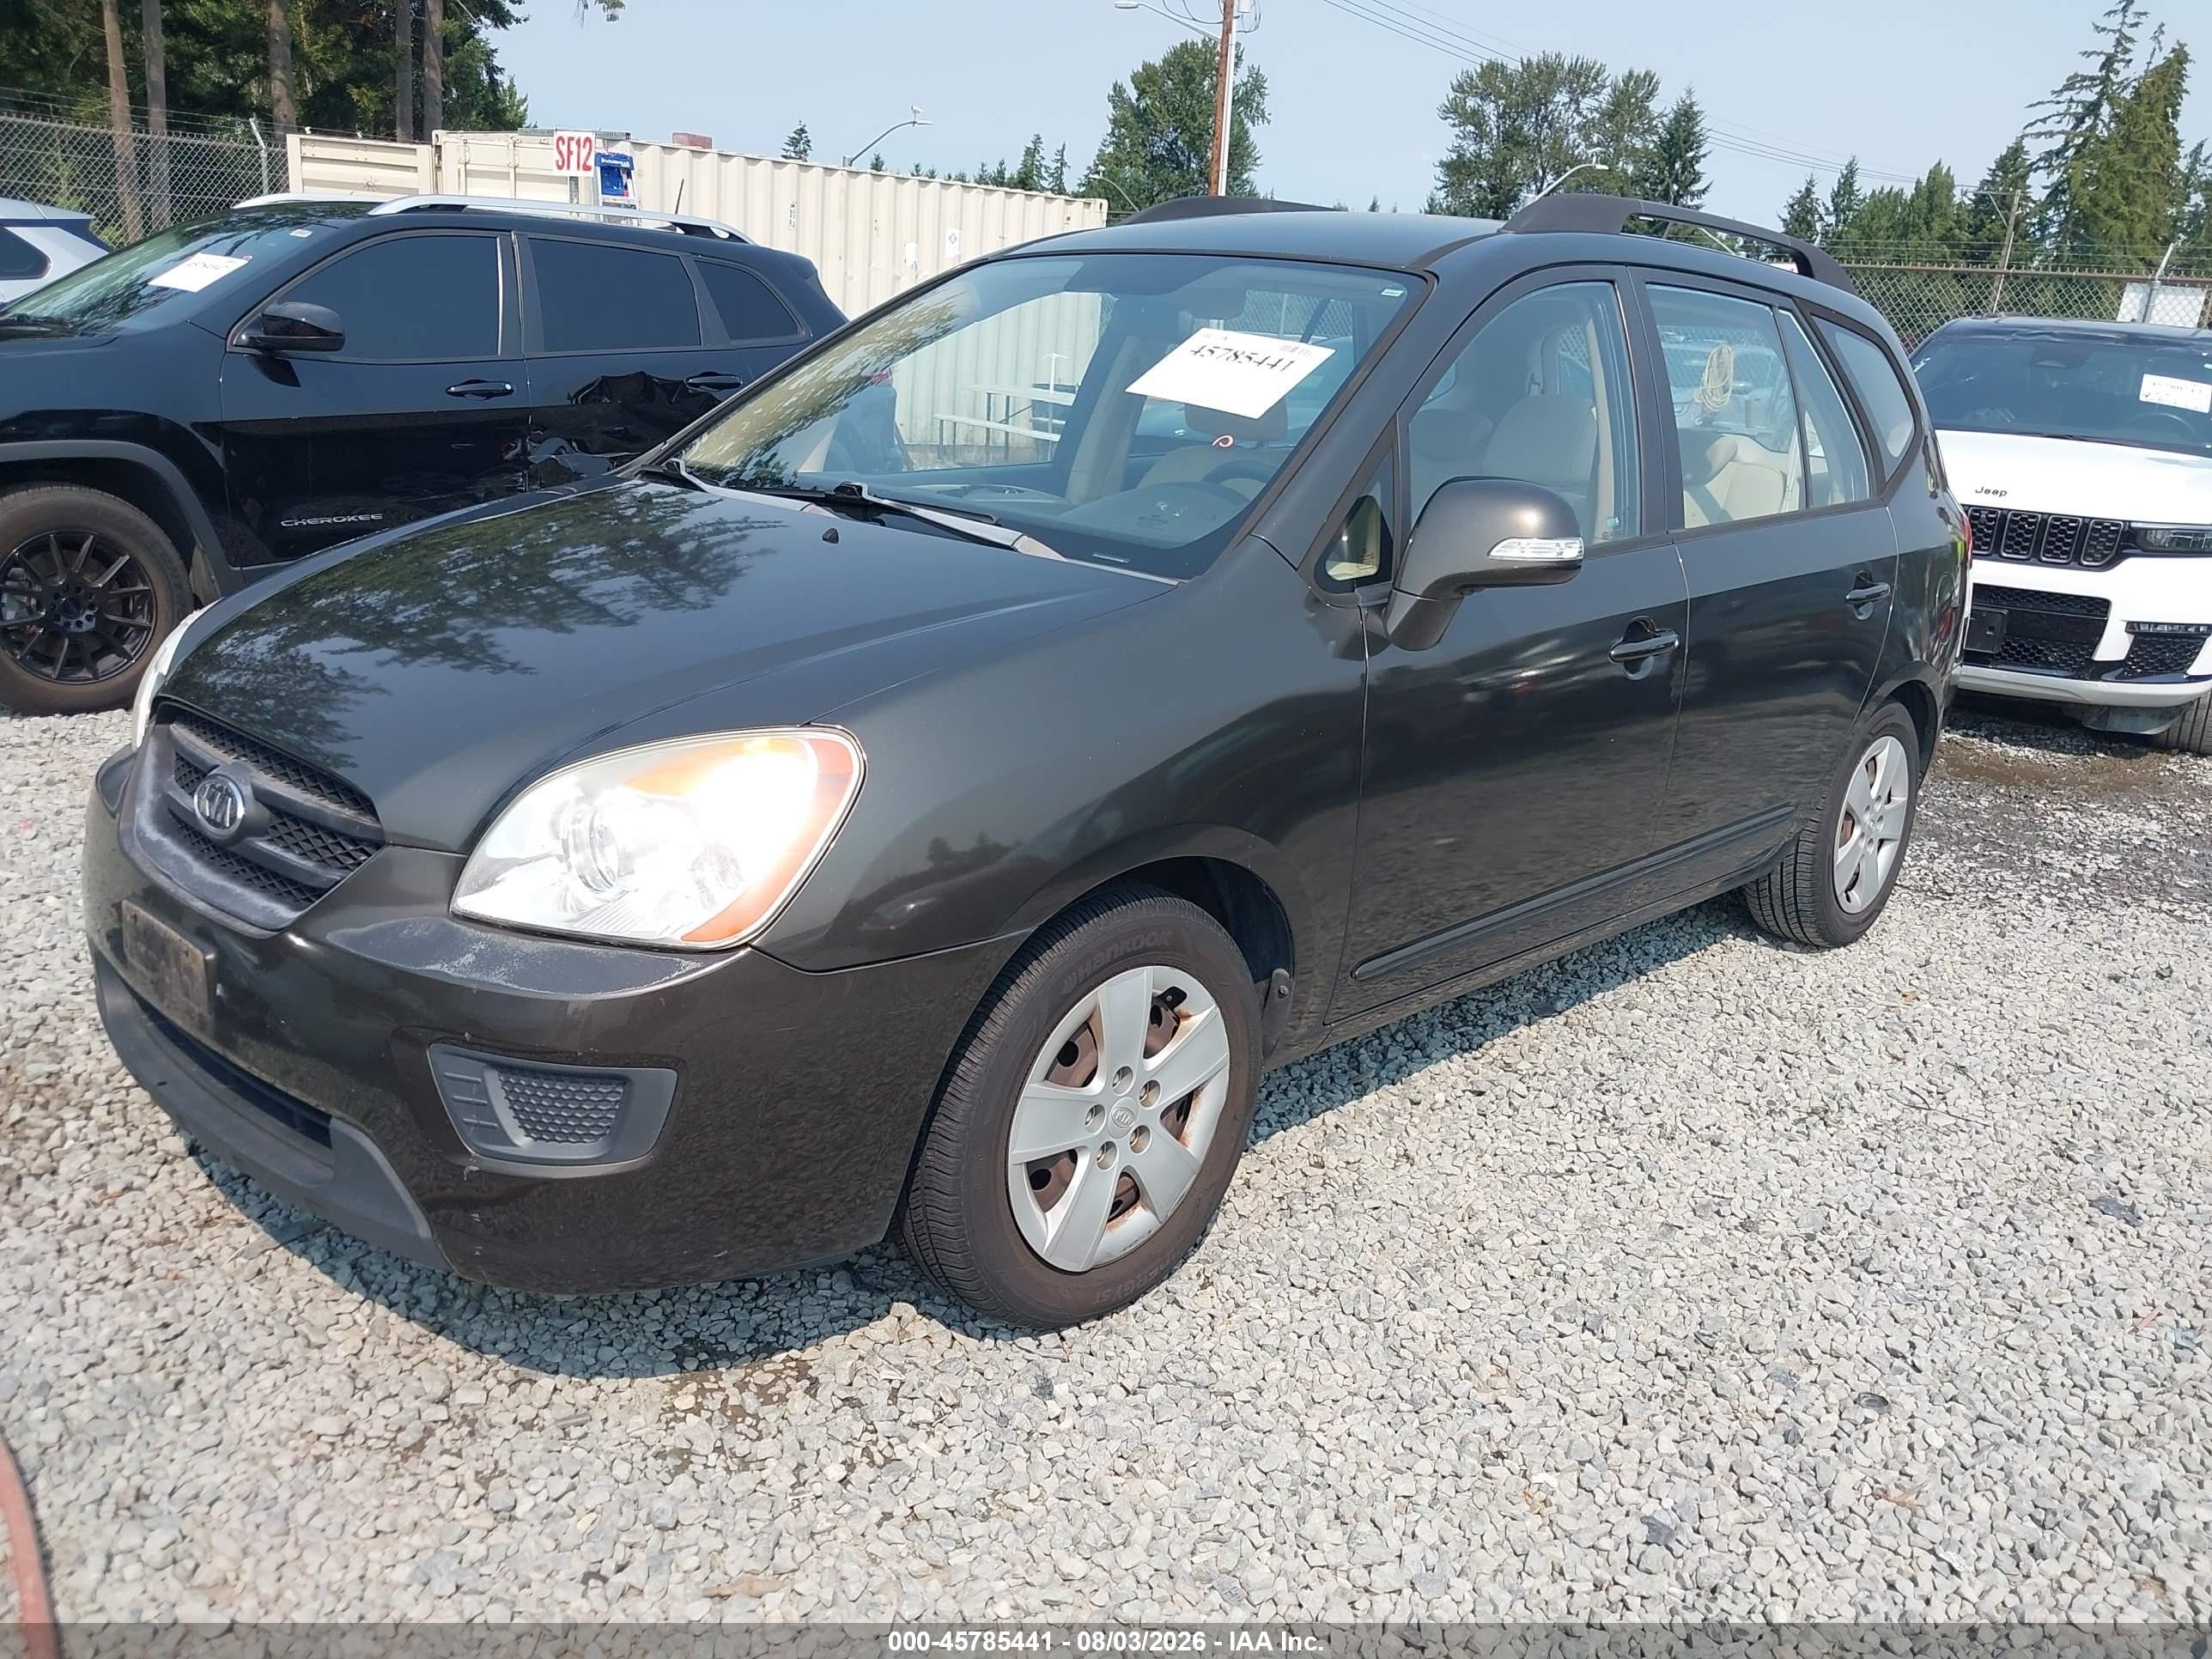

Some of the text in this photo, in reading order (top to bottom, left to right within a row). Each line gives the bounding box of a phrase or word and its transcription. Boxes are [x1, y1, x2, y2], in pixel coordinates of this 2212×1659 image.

[556, 136, 592, 171] SF12
[1190, 344, 1296, 372] 45785441
[1975, 485, 2008, 497] Jeep
[281, 514, 383, 526] CHEROKEE
